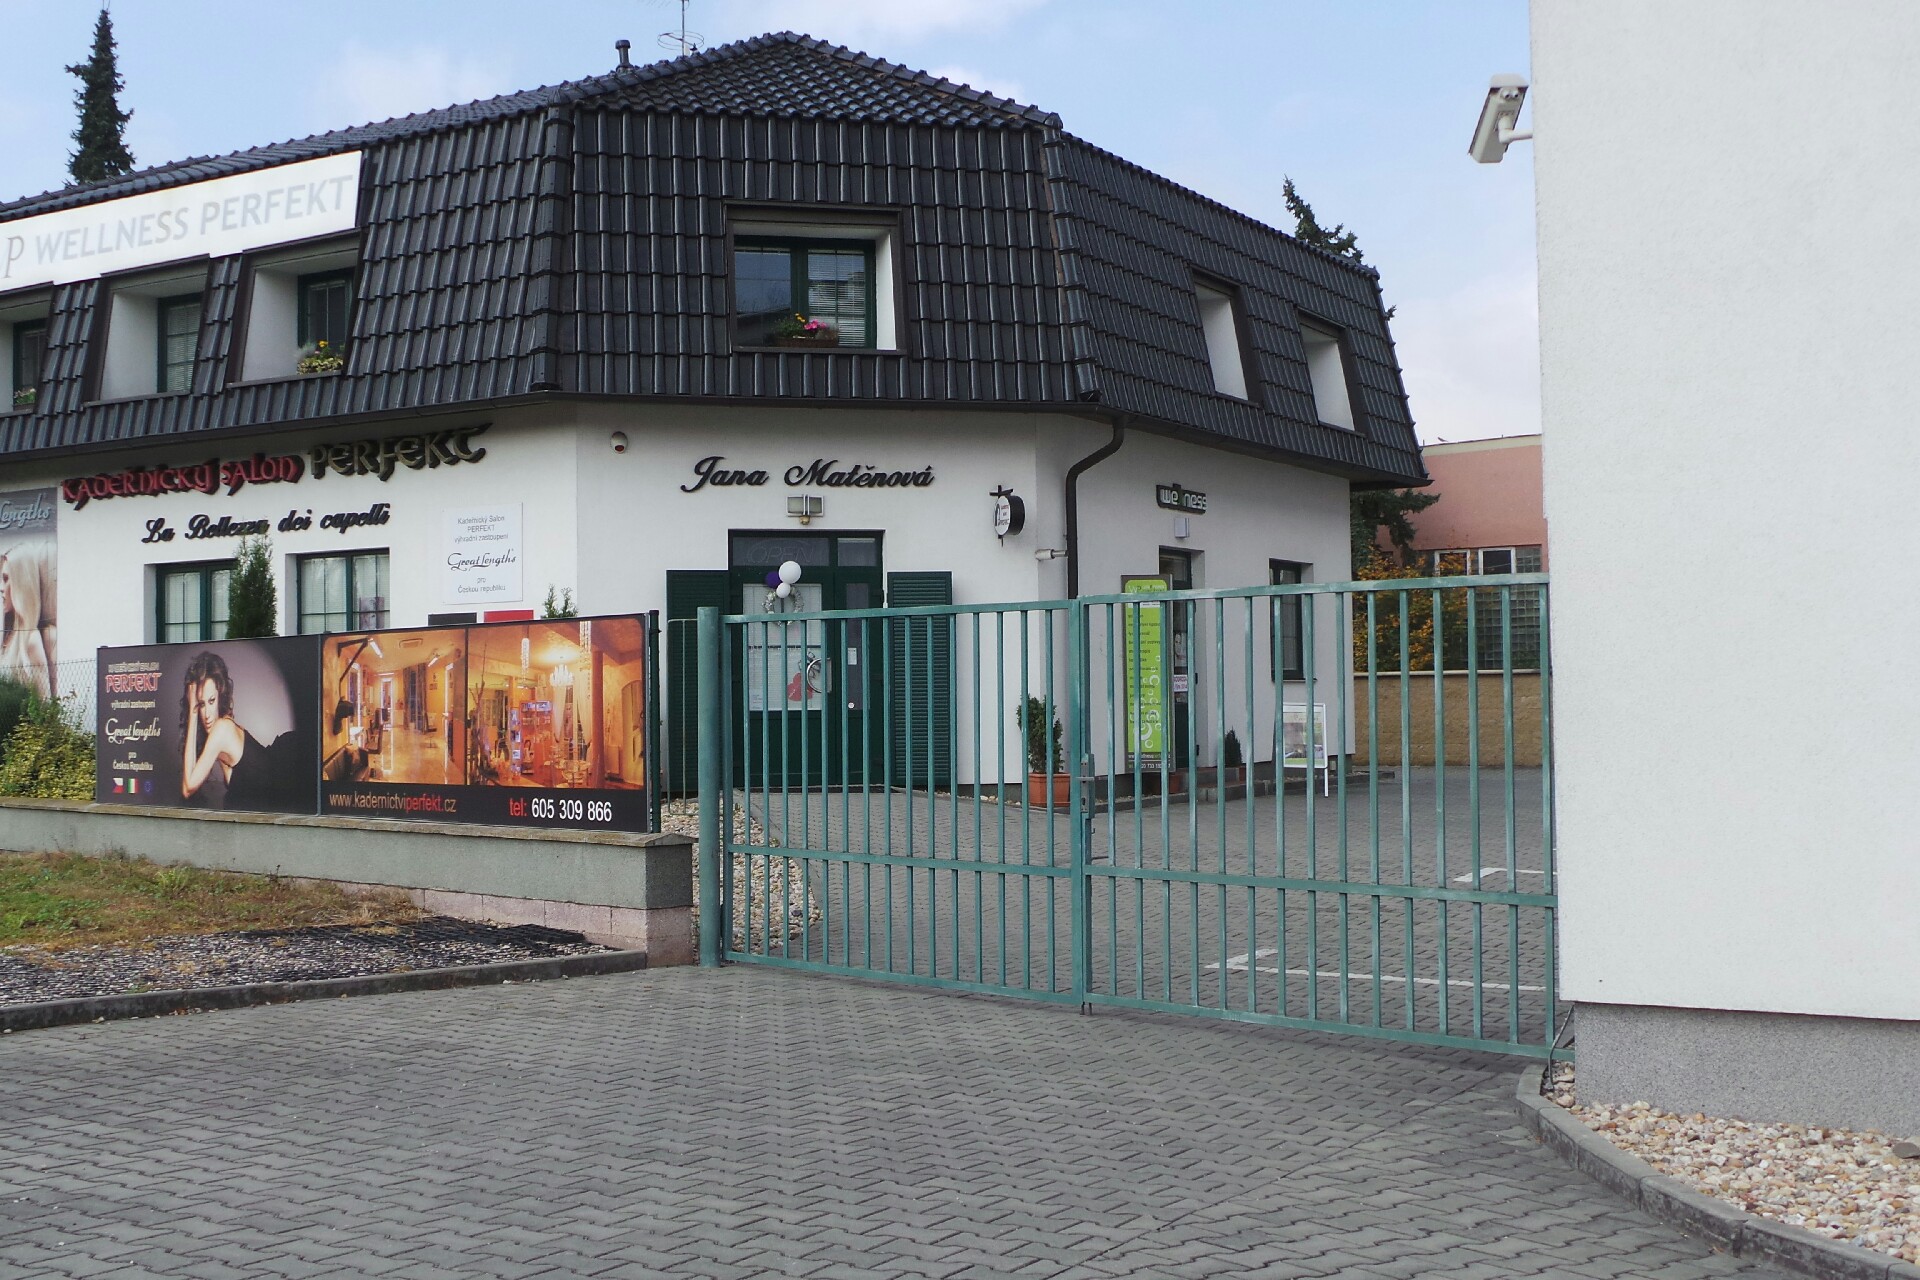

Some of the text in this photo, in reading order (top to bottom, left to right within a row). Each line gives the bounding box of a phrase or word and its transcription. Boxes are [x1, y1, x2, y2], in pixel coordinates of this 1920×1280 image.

[35, 207, 190, 264] WELLNESS
[199, 174, 354, 236] PERFEKT
[220, 453, 304, 496] SALON
[308, 423, 494, 482] PERFEKT
[680, 455, 936, 493] Jana Matěnová
[1160, 486, 1208, 511] weness
[141, 517, 176, 544] La
[277, 508, 313, 532] dei
[319, 502, 391, 534] capelli
[467, 524, 495, 533] PERFEKT
[488, 515, 505, 523] Salon
[105, 672, 163, 693] PERFEKT
[329, 790, 457, 814] www.kadernictviperfekt.cz
[509, 797, 612, 822] tel: 605 309 866
